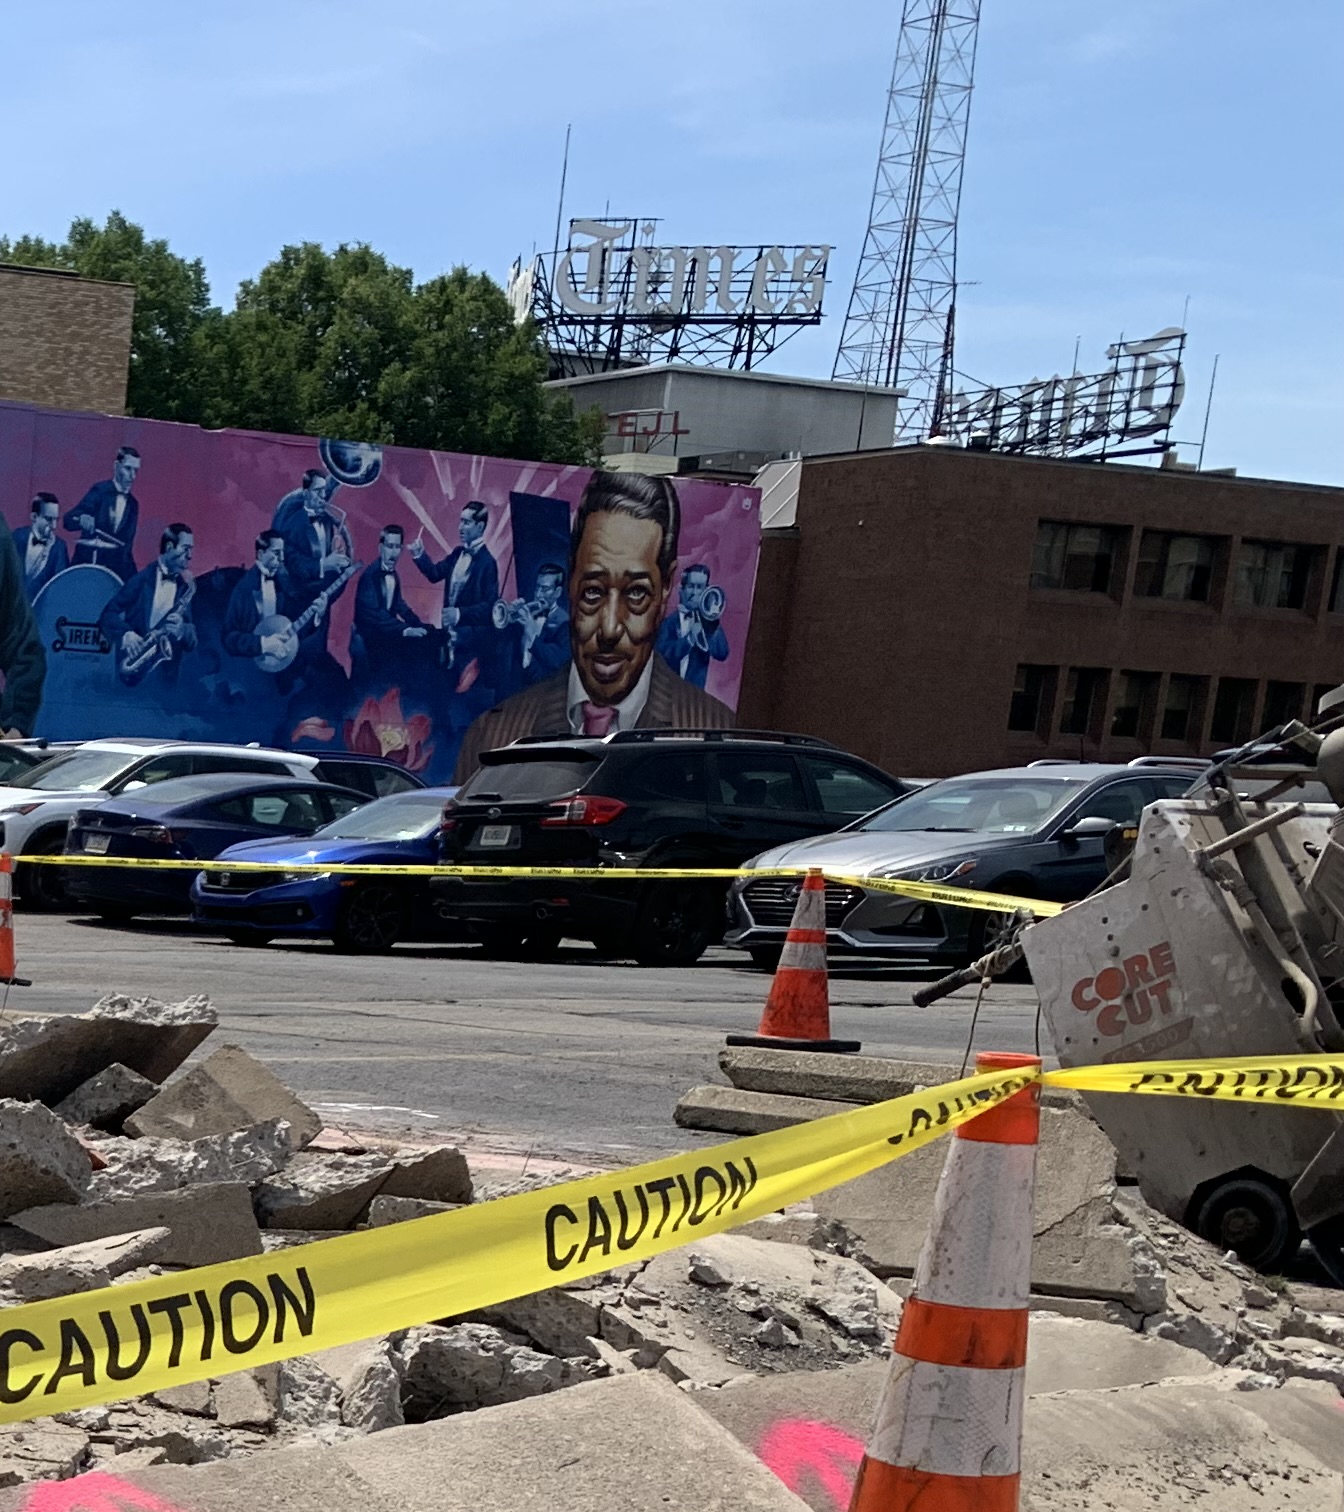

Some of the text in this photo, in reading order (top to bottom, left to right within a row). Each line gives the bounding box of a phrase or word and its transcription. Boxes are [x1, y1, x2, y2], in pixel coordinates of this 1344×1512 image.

[556, 218, 832, 317] Times
[614, 411, 690, 436] EJL
[1071, 940, 1177, 1012] CORE
[1096, 979, 1172, 1037] CUT
[544, 1156, 758, 1272] CAUTION
